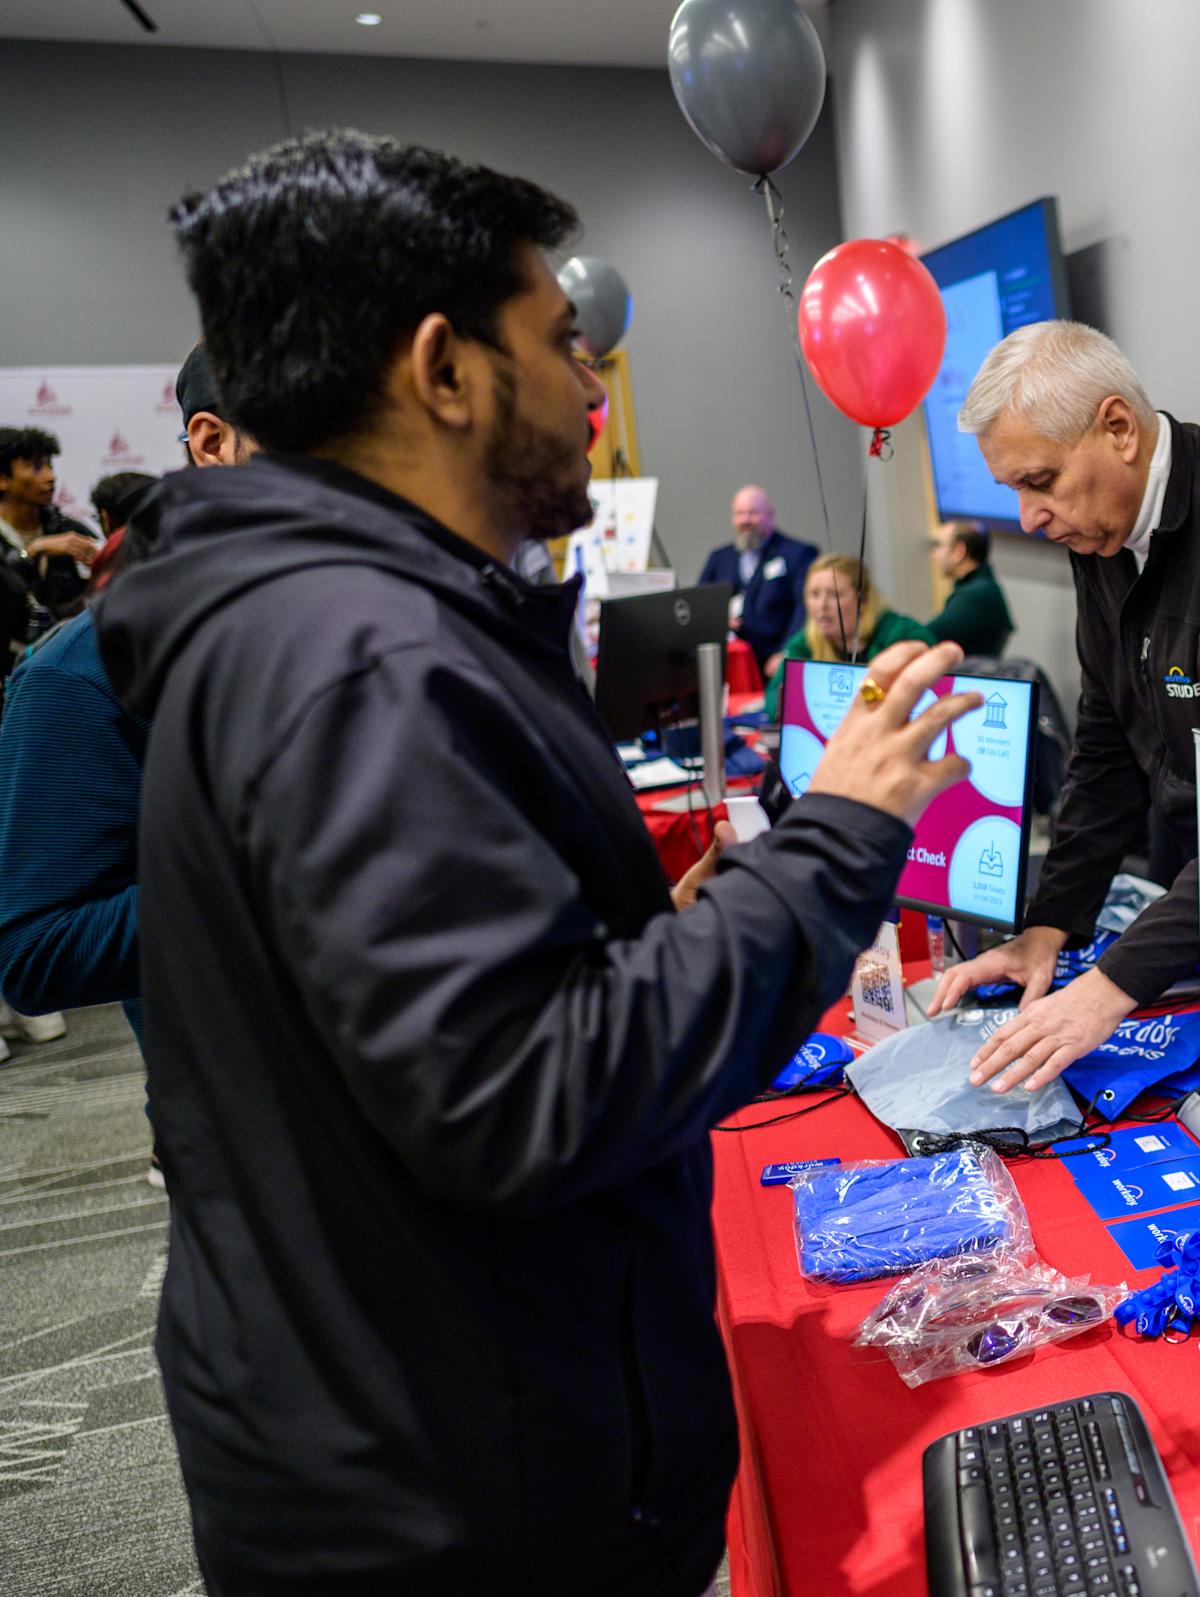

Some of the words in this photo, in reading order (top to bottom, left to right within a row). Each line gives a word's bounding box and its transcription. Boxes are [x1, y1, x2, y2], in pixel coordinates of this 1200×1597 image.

[916, 848, 946, 868] Check
[1112, 1179, 1138, 1206] workday
[1147, 1223, 1168, 1245] work
